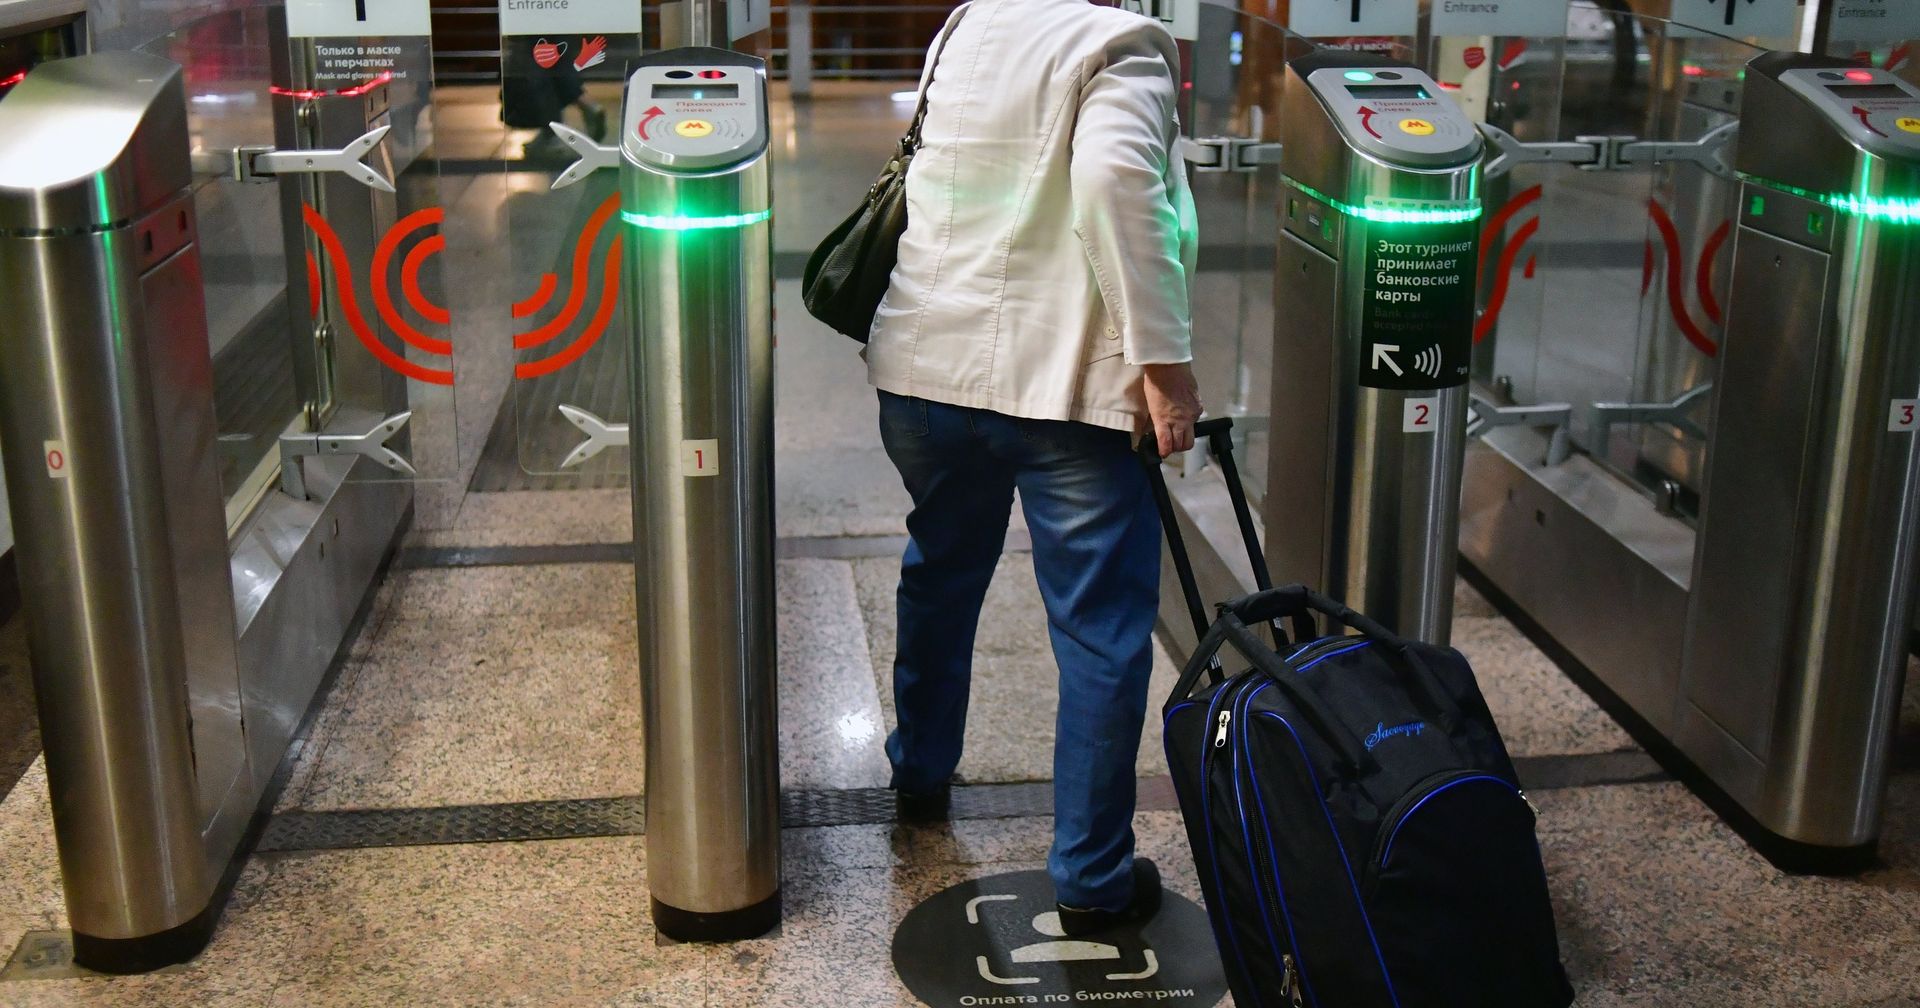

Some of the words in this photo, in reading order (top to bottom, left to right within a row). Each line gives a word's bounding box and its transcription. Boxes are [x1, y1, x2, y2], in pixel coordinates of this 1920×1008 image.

[1444, 1, 1498, 13] Entrance
[315, 45, 354, 55] Только
[357, 46, 364, 55] в
[366, 46, 401, 54] маске
[324, 60, 332, 68] и
[334, 58, 394, 69] перчатках
[315, 72, 336, 80] Mask
[351, 71, 374, 81] gloves
[1378, 240, 1412, 254] Этот
[1415, 241, 1472, 257] турникет
[1377, 258, 1458, 272] принимает
[1376, 271, 1461, 287] банковские
[1375, 290, 1421, 304] карты
[1414, 404, 1429, 425] 2
[1899, 405, 1914, 425] 3
[48, 450, 64, 470] 0
[694, 449, 703, 469] 1
[959, 995, 1038, 1007] Оплата
[1044, 993, 1070, 1002] по
[1075, 988, 1195, 1002] биометрии
